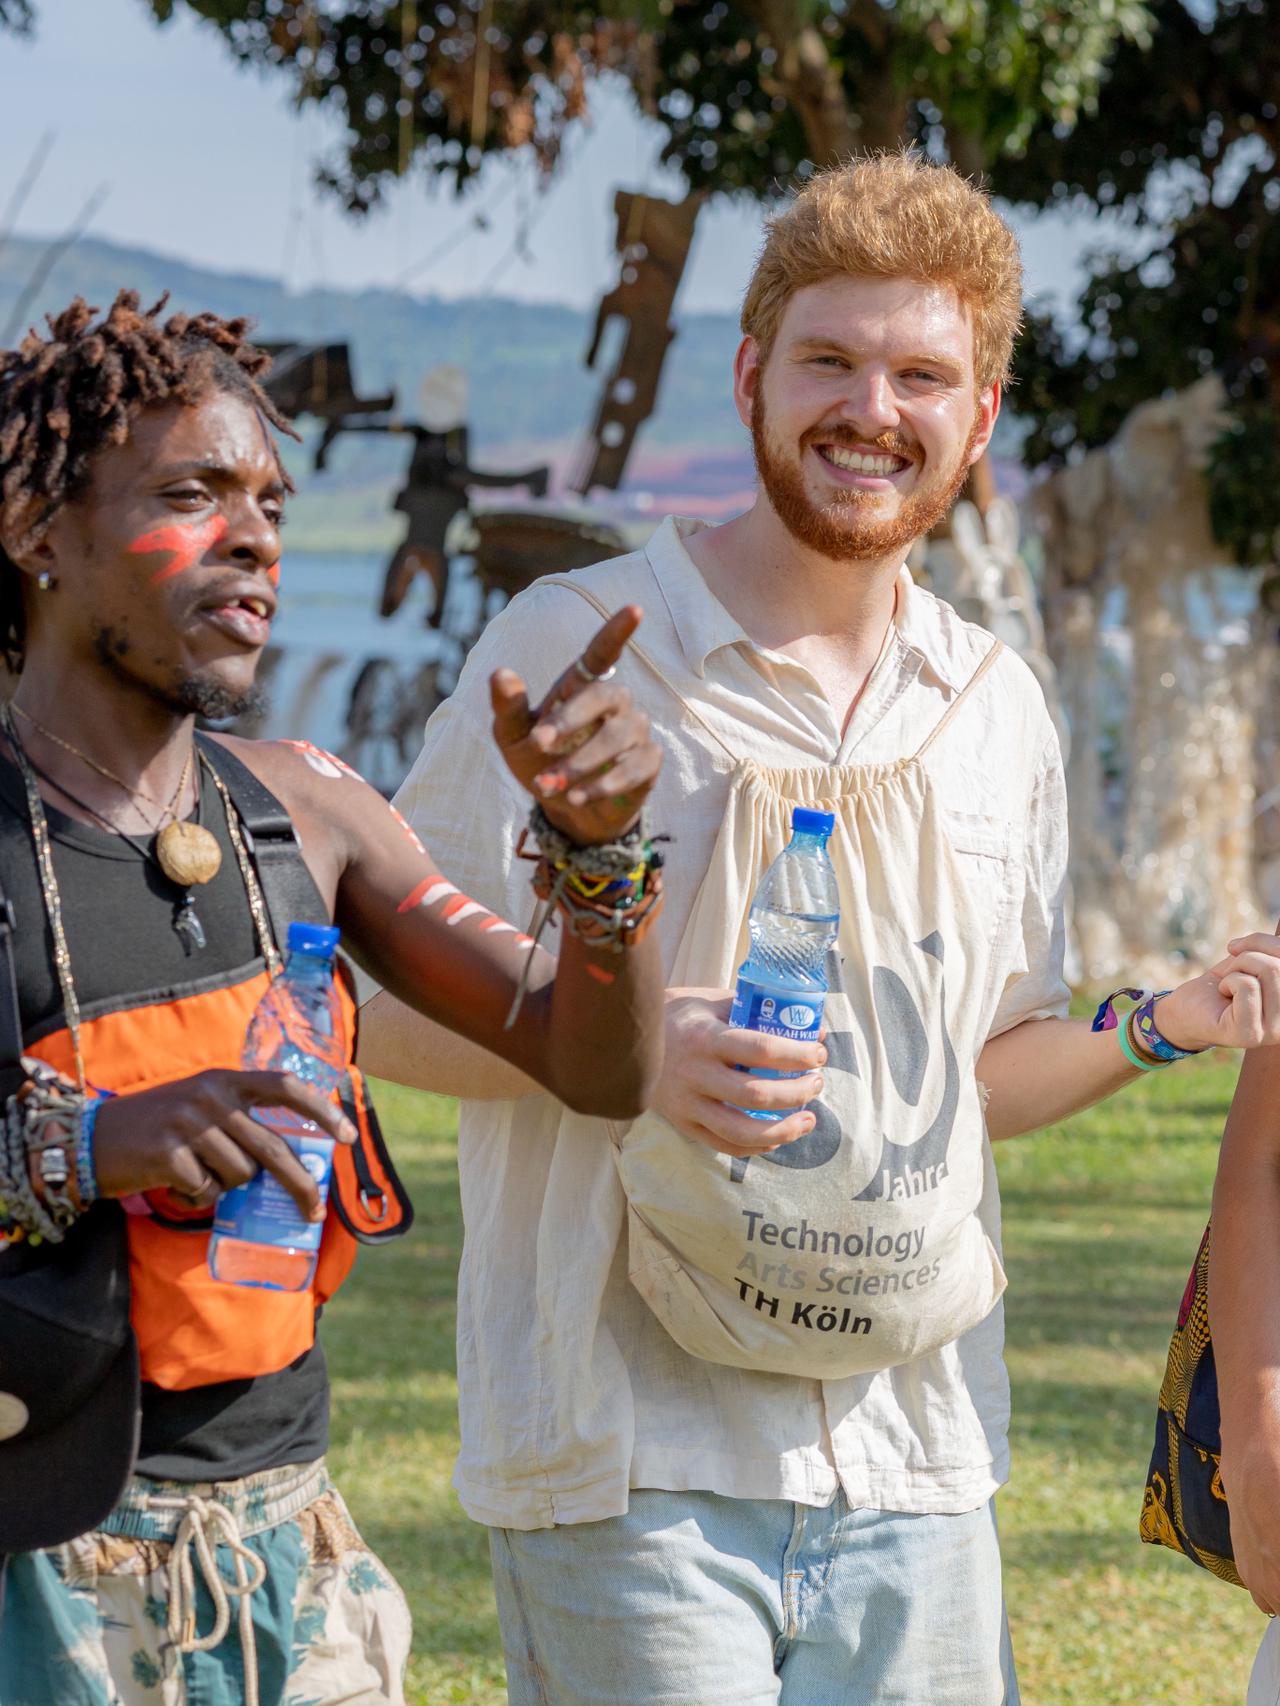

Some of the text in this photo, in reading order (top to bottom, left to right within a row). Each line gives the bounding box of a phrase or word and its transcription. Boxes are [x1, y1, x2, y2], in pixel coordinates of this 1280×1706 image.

[742, 1210, 926, 1263] Technology
[736, 1251, 941, 1296] Arts Sciences
[734, 1276, 873, 1335] TH Köln
